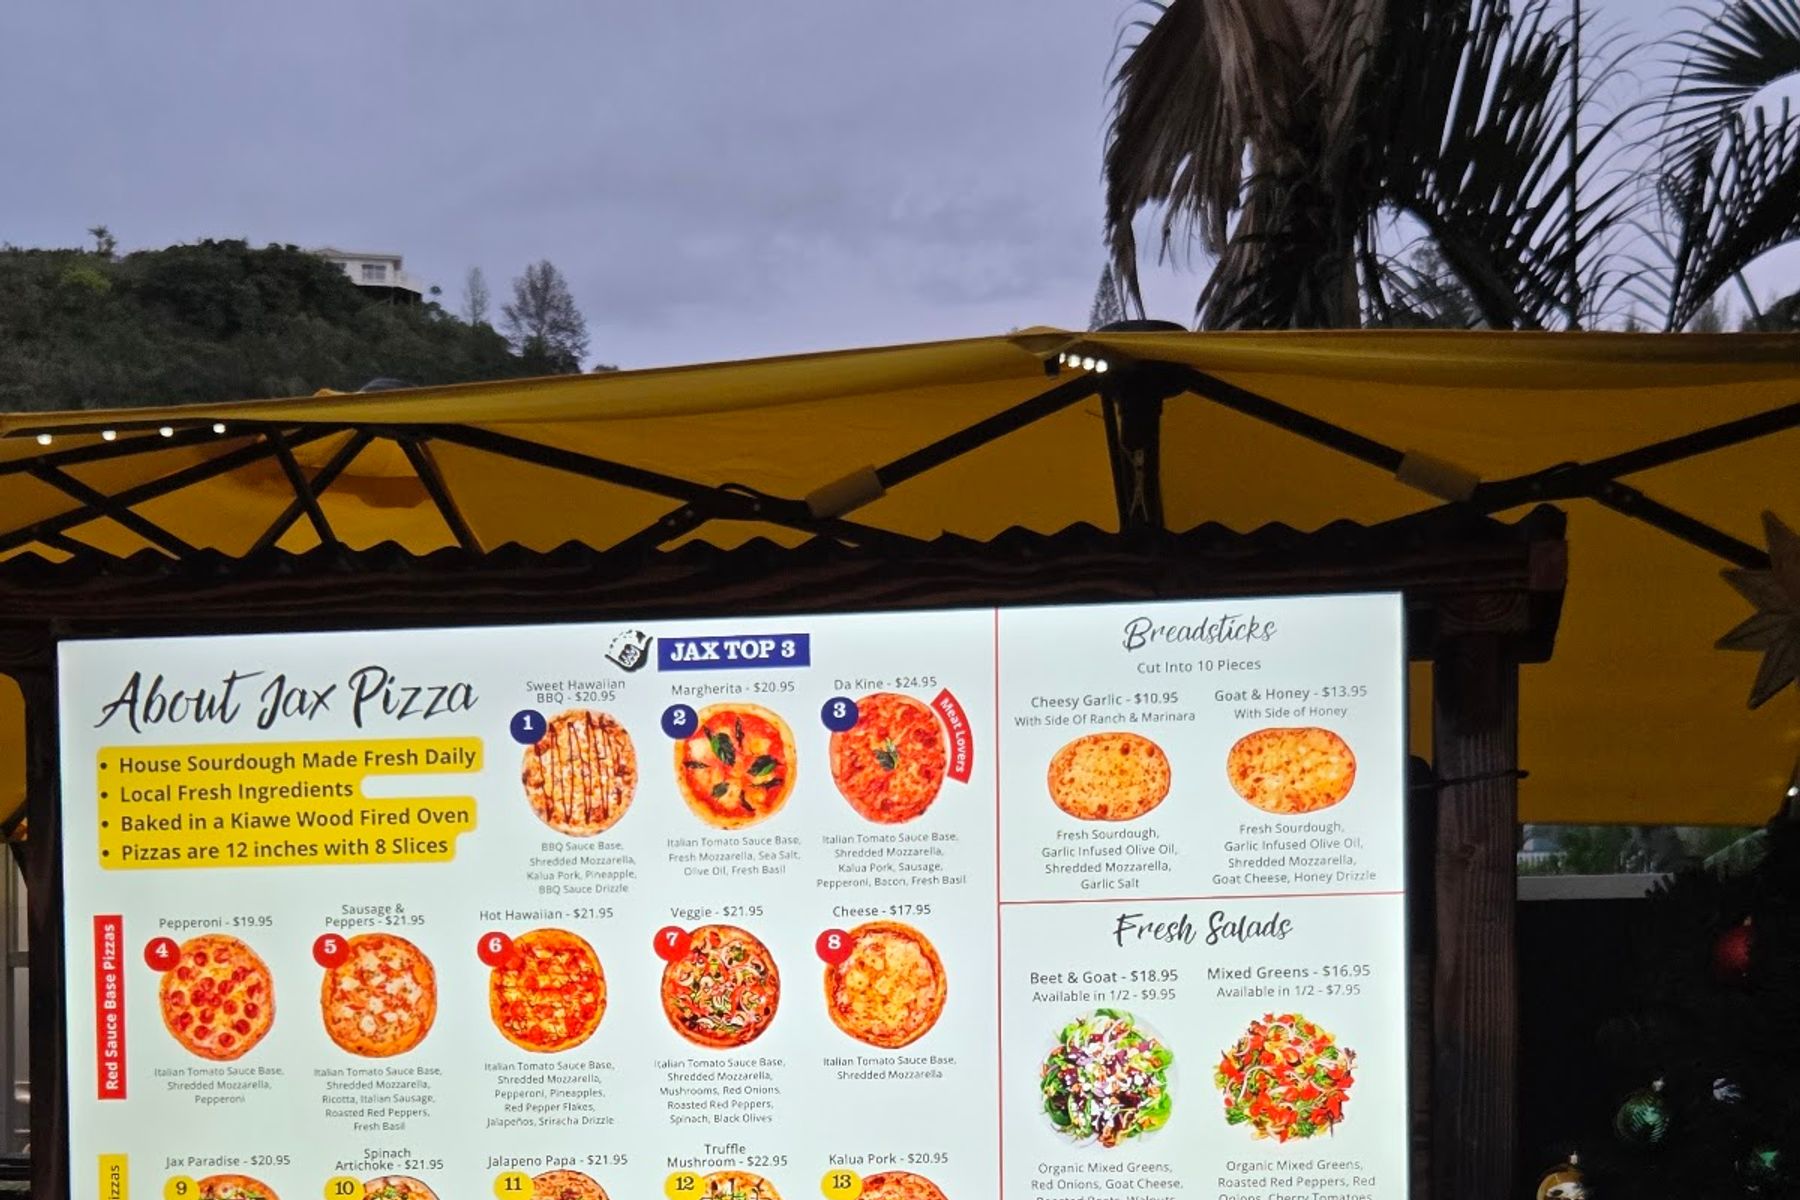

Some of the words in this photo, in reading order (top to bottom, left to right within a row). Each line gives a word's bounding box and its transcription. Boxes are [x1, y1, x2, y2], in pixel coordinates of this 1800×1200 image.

[1122, 614, 1278, 653] Breadsticks
[670, 641, 720, 662] JAX
[723, 639, 776, 660] TOP
[781, 640, 796, 658] 3
[1137, 662, 1161, 674] Cut
[1165, 661, 1193, 673] Into
[1198, 660, 1214, 672] 10
[1218, 659, 1262, 671] Pieces
[526, 680, 564, 694] Sweet
[568, 680, 626, 693] Hawaiian
[671, 683, 742, 698] Margherita
[753, 681, 795, 693] $20.95
[834, 679, 852, 690] Da
[855, 678, 884, 690] Kine
[895, 676, 937, 689] $24.95
[94, 669, 265, 733] About
[257, 674, 338, 730] Jax
[348, 665, 479, 728] Pizza
[536, 691, 564, 705] BBQ
[575, 690, 616, 702] $20.95
[1030, 696, 1080, 710] Cheesy
[1083, 693, 1122, 706] Garlic
[1134, 691, 1179, 705] $10.95
[673, 709, 686, 726] 2
[833, 701, 846, 719] 3
[522, 717, 533, 729] 1
[939, 698, 964, 727] Meat
[955, 728, 967, 772] Lovers
[120, 757, 181, 774] House
[187, 752, 295, 774] Sourdough
[303, 750, 357, 768] Made
[364, 748, 418, 767] Fresh
[426, 747, 476, 769] Daily
[120, 784, 171, 803] Local
[178, 783, 232, 801] Fresh
[239, 781, 353, 804] Ingredients
[121, 813, 182, 832] Baked
[189, 813, 207, 830] in
[213, 816, 224, 830] a
[231, 812, 291, 829] Kiawe
[296, 808, 353, 827] Wood
[360, 807, 410, 826] Fired
[417, 808, 469, 824] Oven
[1057, 829, 1089, 841] Fresh
[1091, 827, 1159, 841] Sourdough,
[122, 844, 181, 861] Pizzas
[187, 846, 220, 860] are
[226, 842, 248, 858] 12
[254, 840, 318, 858] inches
[324, 838, 369, 856] with
[375, 838, 386, 855] 8
[392, 837, 448, 854] Slices
[1113, 913, 1197, 947] Fresh
[1205, 910, 1293, 945] Salads
[325, 939, 336, 954] 5
[489, 939, 501, 952] 6
[666, 932, 679, 946] 7
[828, 935, 840, 949] 8
[104, 924, 115, 971] Pizzas
[156, 944, 168, 958] 4
[1207, 966, 1252, 980] Mixed
[1256, 966, 1309, 979] Greens
[1322, 964, 1371, 977] $16.95
[104, 974, 117, 1009] Base
[104, 1012, 118, 1059] Sauce
[105, 1062, 118, 1090] Red
[1038, 1162, 1084, 1176] Organic
[1087, 1162, 1124, 1173] Mixed
[176, 1182, 187, 1196] 9
[335, 1182, 354, 1195] 10
[504, 1177, 522, 1191] 11
[676, 1176, 695, 1191] 12
[833, 1175, 852, 1188] 13
